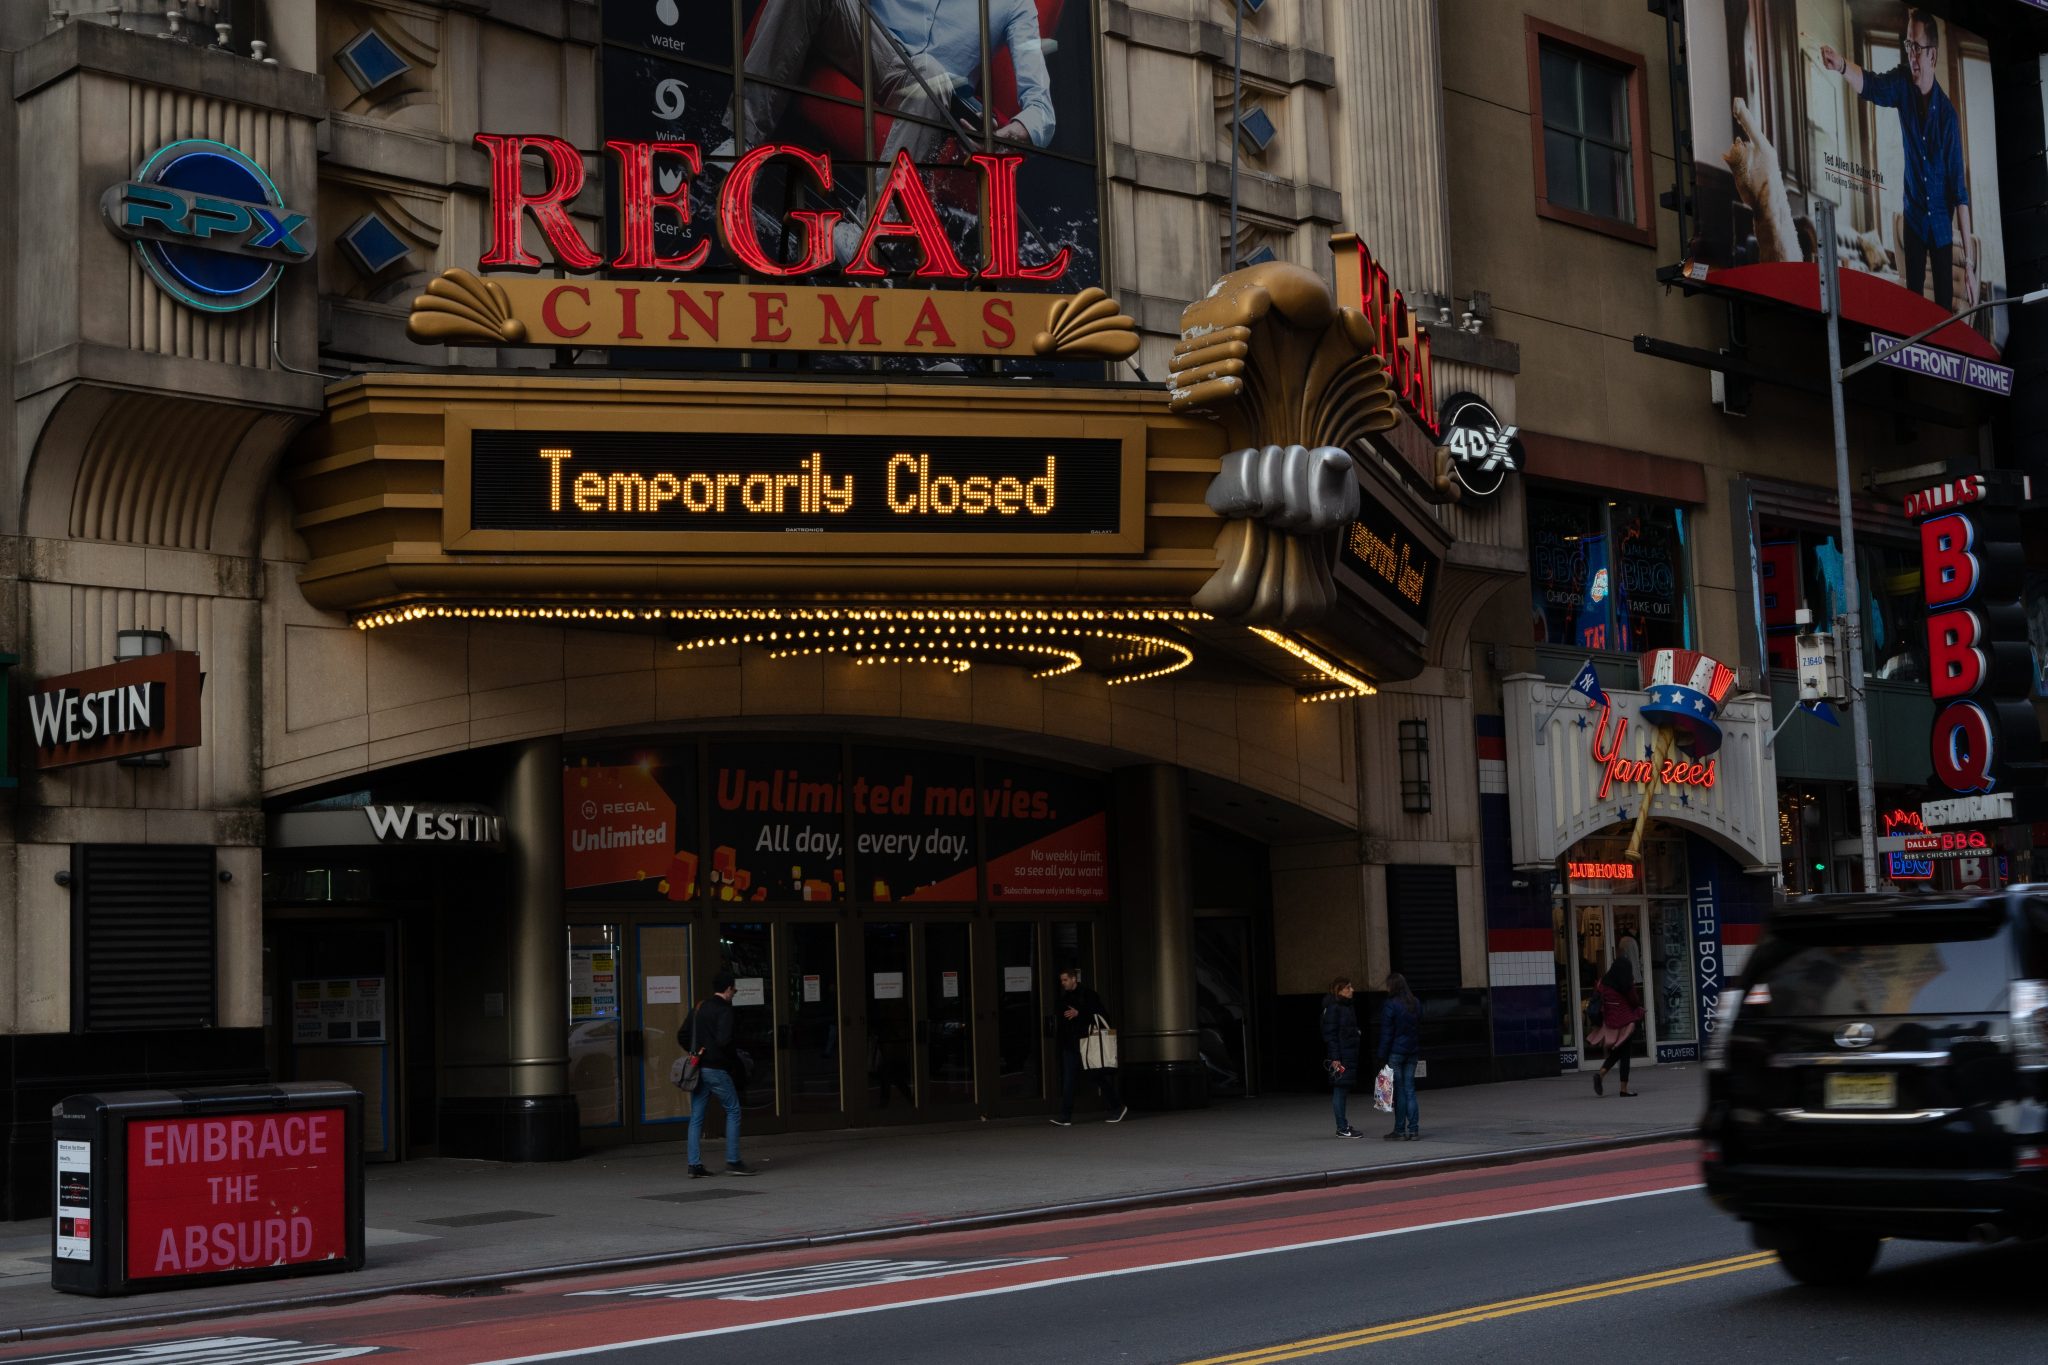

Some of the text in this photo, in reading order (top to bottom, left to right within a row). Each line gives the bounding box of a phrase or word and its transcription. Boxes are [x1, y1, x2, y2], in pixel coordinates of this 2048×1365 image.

[126, 183, 309, 256] RPX
[473, 132, 1073, 282] REGAL
[541, 284, 1017, 350] CINEMAS
[1969, 362, 2009, 392] PRIME
[1449, 425, 1518, 471] 4DX
[540, 449, 1056, 515] Temporarily Closed
[1903, 474, 1986, 521] DALLAS
[28, 680, 153, 748] WESTIN
[602, 801, 656, 815] REGAL
[717, 767, 1058, 822] Unlimited movies.
[363, 804, 507, 843] WESTIN
[571, 821, 667, 852] Unlimited
[755, 824, 969, 862] All day, every day.
[1907, 840, 1938, 849] DALLAS
[1941, 831, 1987, 850] BBQ
[1014, 866, 1026, 877] so
[1027, 866, 1044, 877] see
[1045, 864, 1057, 877] all
[1058, 868, 1075, 880] you
[1031, 849, 1044, 861] No
[1045, 849, 1078, 864] weekly
[1926, 851, 1957, 859] CHICKEN
[1964, 849, 1991, 857] STEAKS
[1699, 941, 1718, 989] BOX
[1666, 1047, 1695, 1059] PLAYERS
[144, 1116, 327, 1168] EMBRACE
[207, 1174, 259, 1205] THE
[154, 1216, 313, 1272] ABSURD
